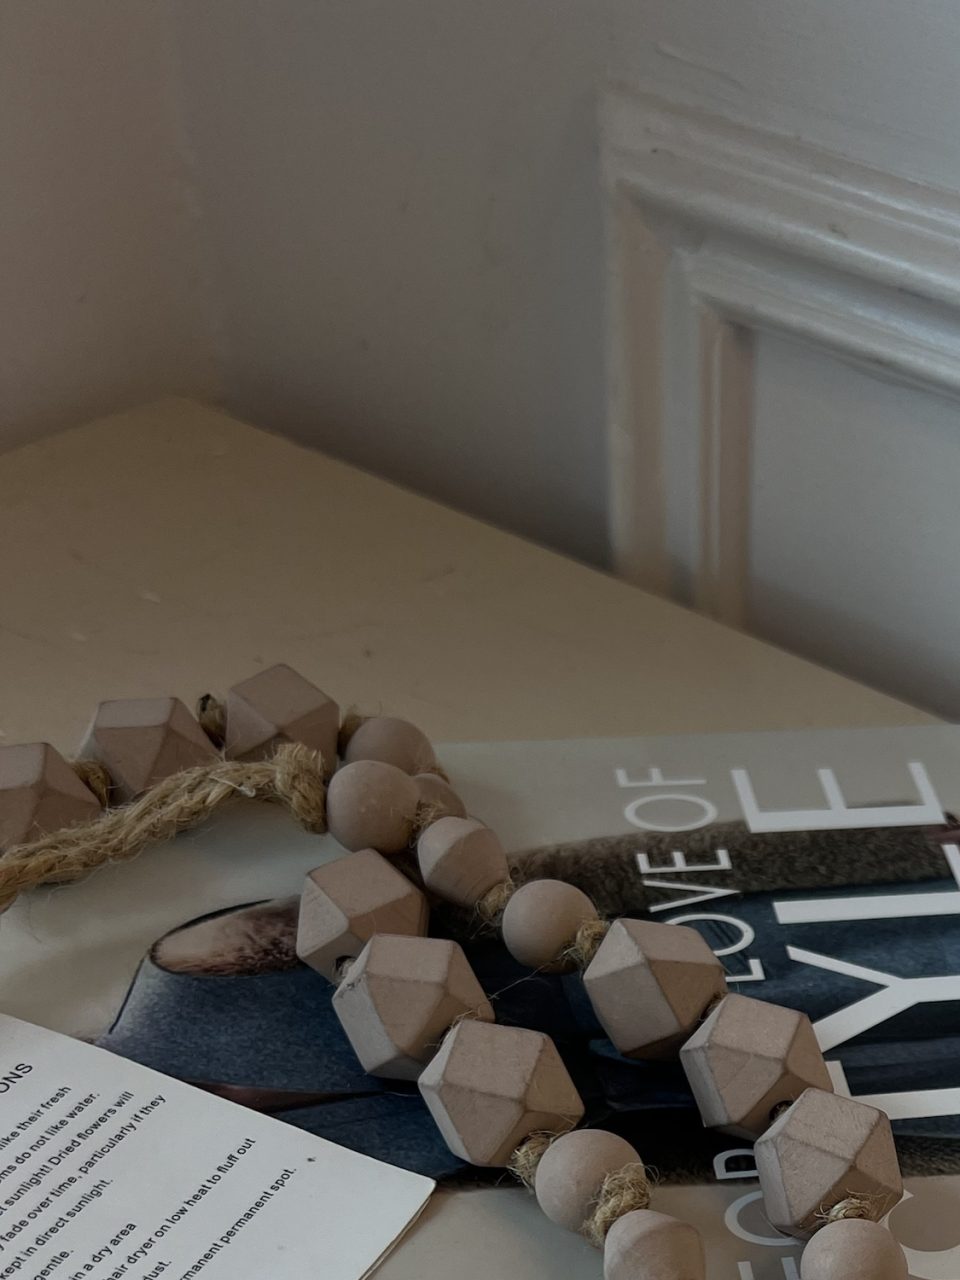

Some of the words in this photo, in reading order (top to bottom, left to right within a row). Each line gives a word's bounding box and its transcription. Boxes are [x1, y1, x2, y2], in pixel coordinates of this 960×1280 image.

[615, 768, 719, 832] OF
[0, 1164, 17, 1183] ms
[15, 1151, 31, 1165] do
[29, 1135, 51, 1151] not
[44, 1119, 69, 1136] like
[66, 1093, 100, 1119] water.
[4, 1164, 53, 1206] sunlight!
[48, 1139, 82, 1166] Dried
[76, 1107, 117, 1140] flowers
[114, 1091, 134, 1108] will
[16, 1109, 44, 1131] their
[40, 1086, 72, 1110] fresh
[0, 1219, 29, 1242] fade
[27, 1197, 54, 1219] over
[78, 1122, 137, 1174] particularly
[130, 1113, 144, 1124] if
[140, 1094, 167, 1116] they
[127, 1237, 156, 1265] dryer
[154, 1223, 171, 1238] on
[165, 1206, 188, 1225] low
[185, 1184, 212, 1208] heat
[206, 1173, 222, 1185] to
[216, 1153, 239, 1174] fluff
[236, 1137, 256, 1155] out
[219, 1190, 274, 1245] permanent
[270, 1168, 297, 1192] spot.
[0, 1256, 27, 1280] kept
[20, 1246, 38, 1257] in
[35, 1216, 70, 1246] direct
[66, 1179, 113, 1218] sunlight.
[83, 1263, 94, 1272] a
[92, 1245, 113, 1263] dry
[110, 1222, 137, 1247] area
